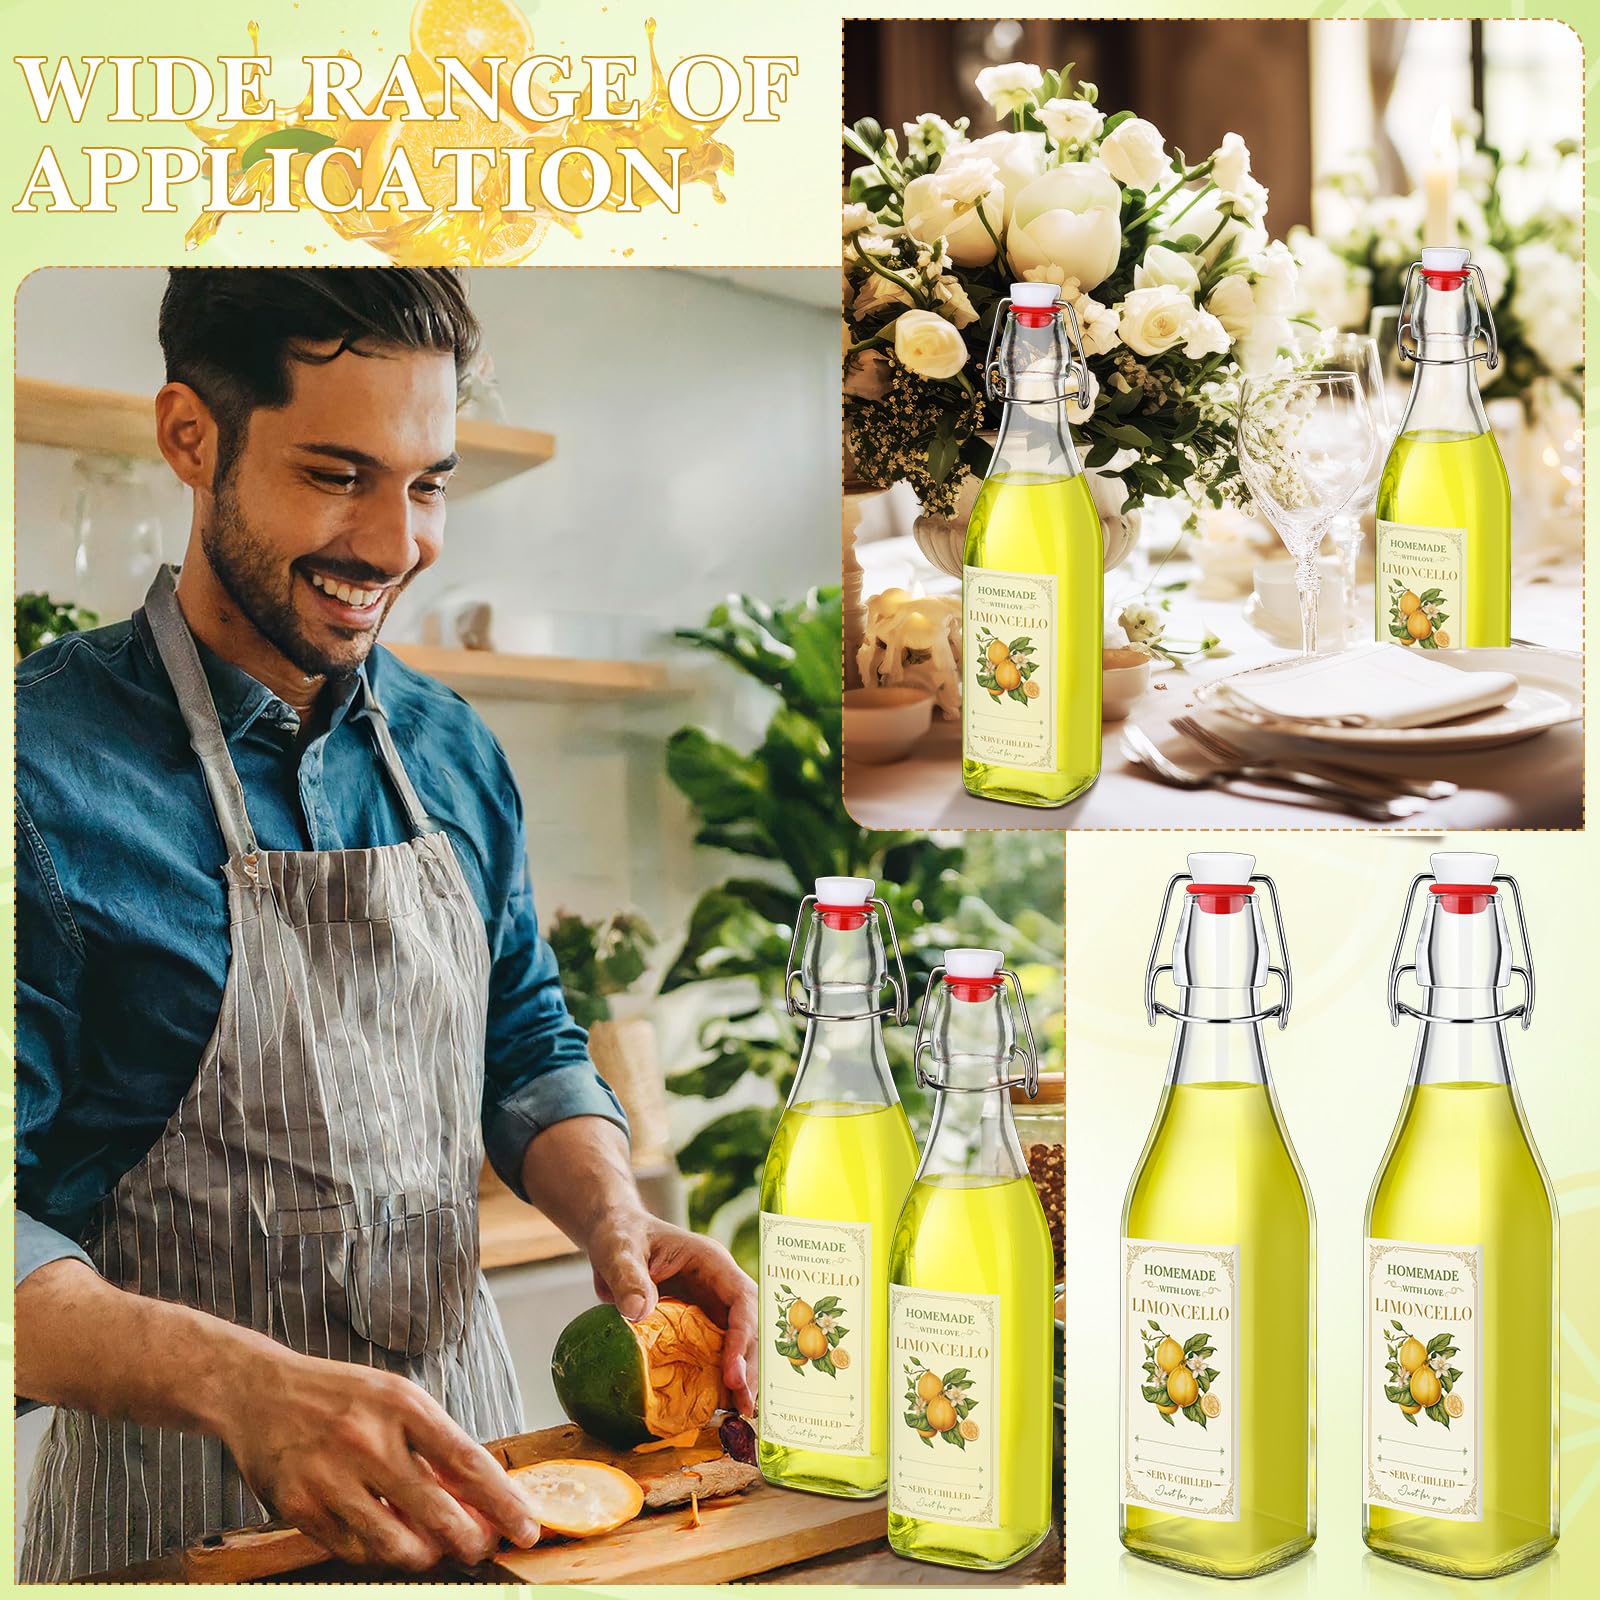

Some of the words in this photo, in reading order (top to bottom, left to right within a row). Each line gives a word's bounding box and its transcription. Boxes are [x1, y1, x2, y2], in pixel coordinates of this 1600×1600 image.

[1390, 539, 1447, 553] HOMEMADE
[1383, 562, 1458, 580] LIMONCELLO
[978, 586, 1037, 600] HOMEMADE
[970, 610, 1048, 629] LIMONCELLO
[777, 1236, 846, 1252] HOMEMADE
[791, 1254, 809, 1262] WITH
[768, 1264, 859, 1287] LIMONCELLO
[1144, 1264, 1216, 1281] HOMEMADE
[1387, 1264, 1459, 1281] HOMEMADE
[1160, 1285, 1179, 1294] WITH
[1181, 1288, 1201, 1296] LOVE
[1402, 1285, 1422, 1294] WITH
[1424, 1288, 1444, 1296] LOVE
[906, 1308, 975, 1324] HOMEMADE
[1133, 1298, 1229, 1321] LIMONCELLO
[1376, 1298, 1472, 1321] LIMONCELLO
[920, 1326, 938, 1334] WITH
[897, 1336, 988, 1358] LIMONCELLO
[1146, 1469, 1174, 1482] SERVE
[1175, 1475, 1212, 1488] CHILLED
[1389, 1469, 1416, 1482] SERVE
[1418, 1475, 1455, 1488] CHILLED
[1155, 1484, 1176, 1496] Just
[1177, 1489, 1187, 1500] for
[1189, 1496, 1203, 1505] you
[1398, 1484, 1419, 1496] Just
[1420, 1489, 1430, 1500] for
[1432, 1496, 1446, 1505] you
